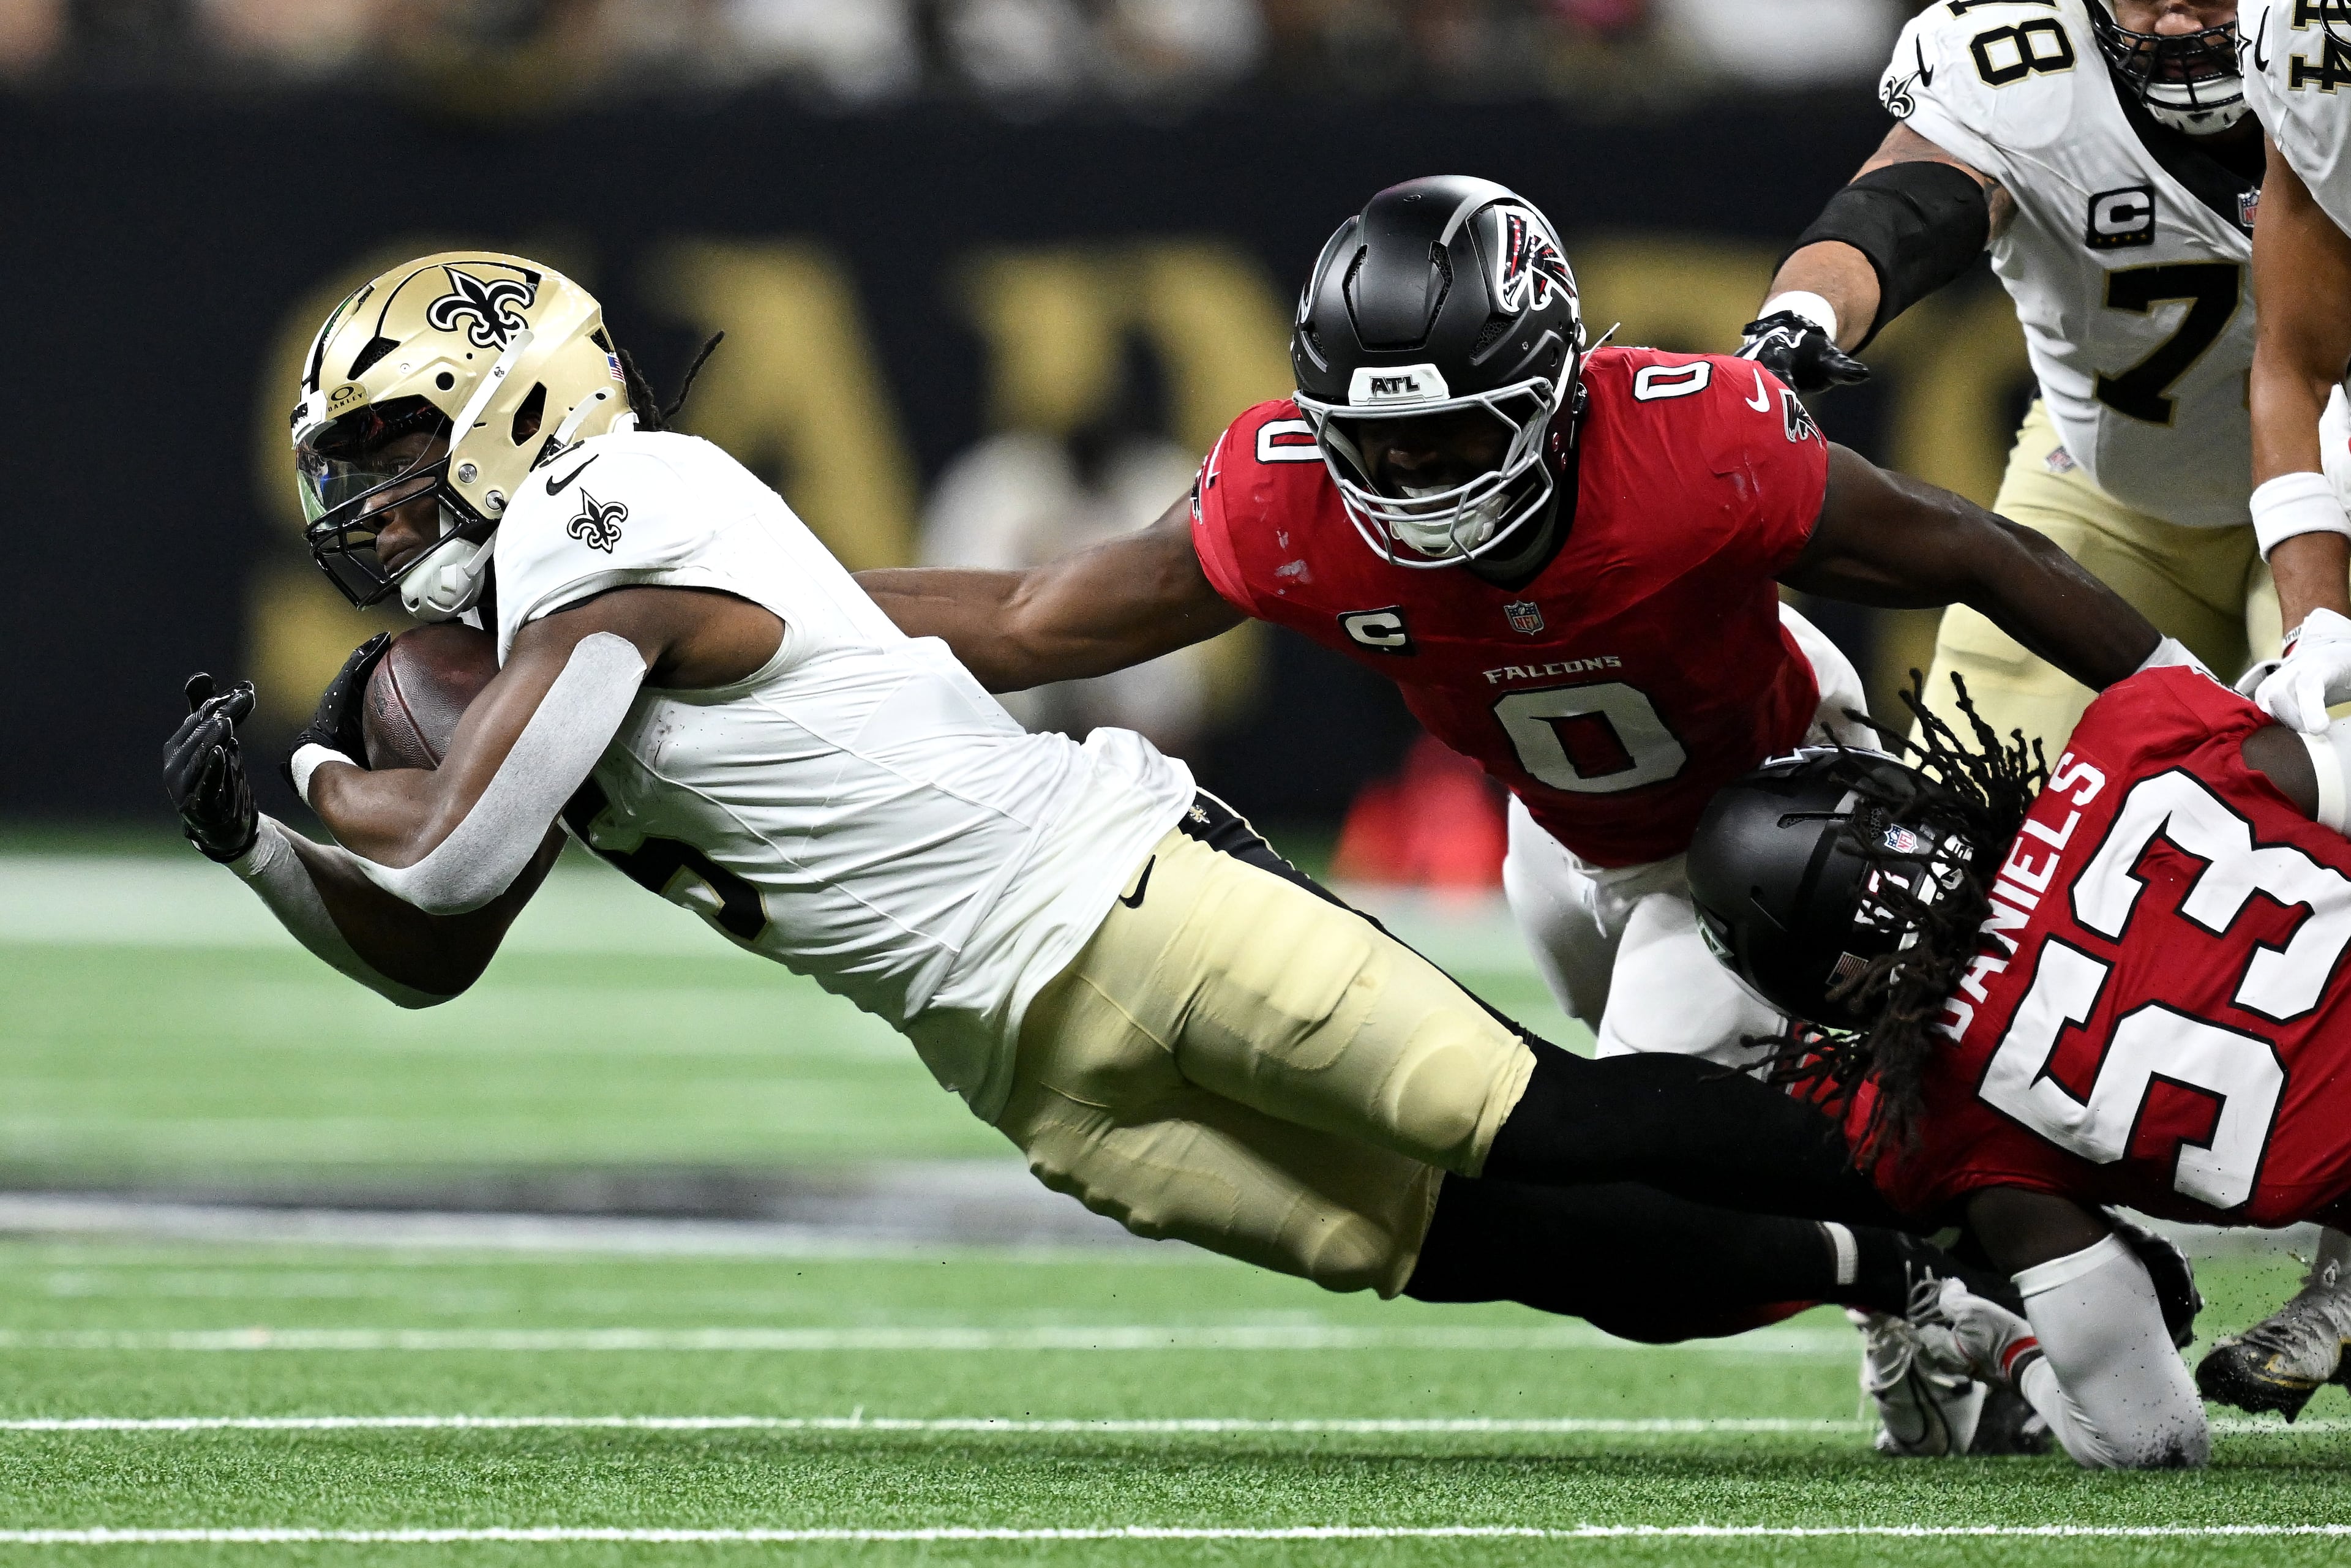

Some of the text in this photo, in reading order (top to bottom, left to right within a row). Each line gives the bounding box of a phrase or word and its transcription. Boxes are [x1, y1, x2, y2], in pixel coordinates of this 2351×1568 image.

[2094, 191, 2150, 235] C
[2095, 257, 2251, 429] 7
[328, 392, 363, 413] OAKLEY
[1369, 374, 1421, 397] ATL
[1632, 361, 1713, 403] 0
[1345, 612, 1406, 647] C
[1482, 656, 1622, 684] FALCONS
[1491, 681, 1687, 794] 0
[1897, 831, 1914, 850] NFL
[1935, 752, 2106, 1043] DANIELS
[1977, 765, 2351, 1211] 53
